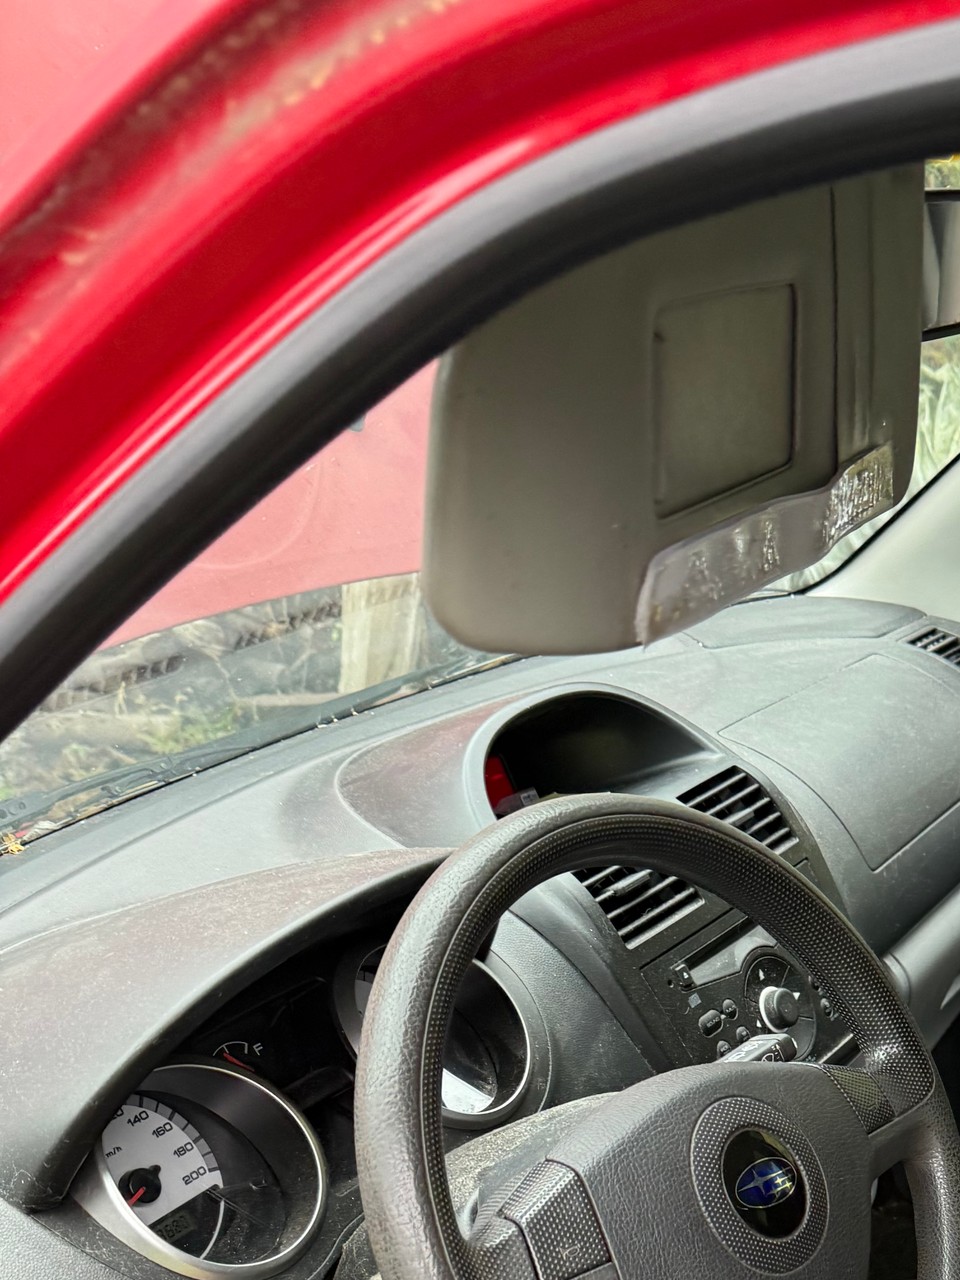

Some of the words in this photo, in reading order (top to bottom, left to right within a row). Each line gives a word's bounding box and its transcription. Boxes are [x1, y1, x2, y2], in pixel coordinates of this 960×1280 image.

[252, 1042, 263, 1056] F
[127, 1110, 149, 1127] 140
[152, 1122, 174, 1138] 160
[105, 1145, 122, 1158] m/h
[173, 1141, 194, 1158] 180
[182, 1166, 207, 1186] 200
